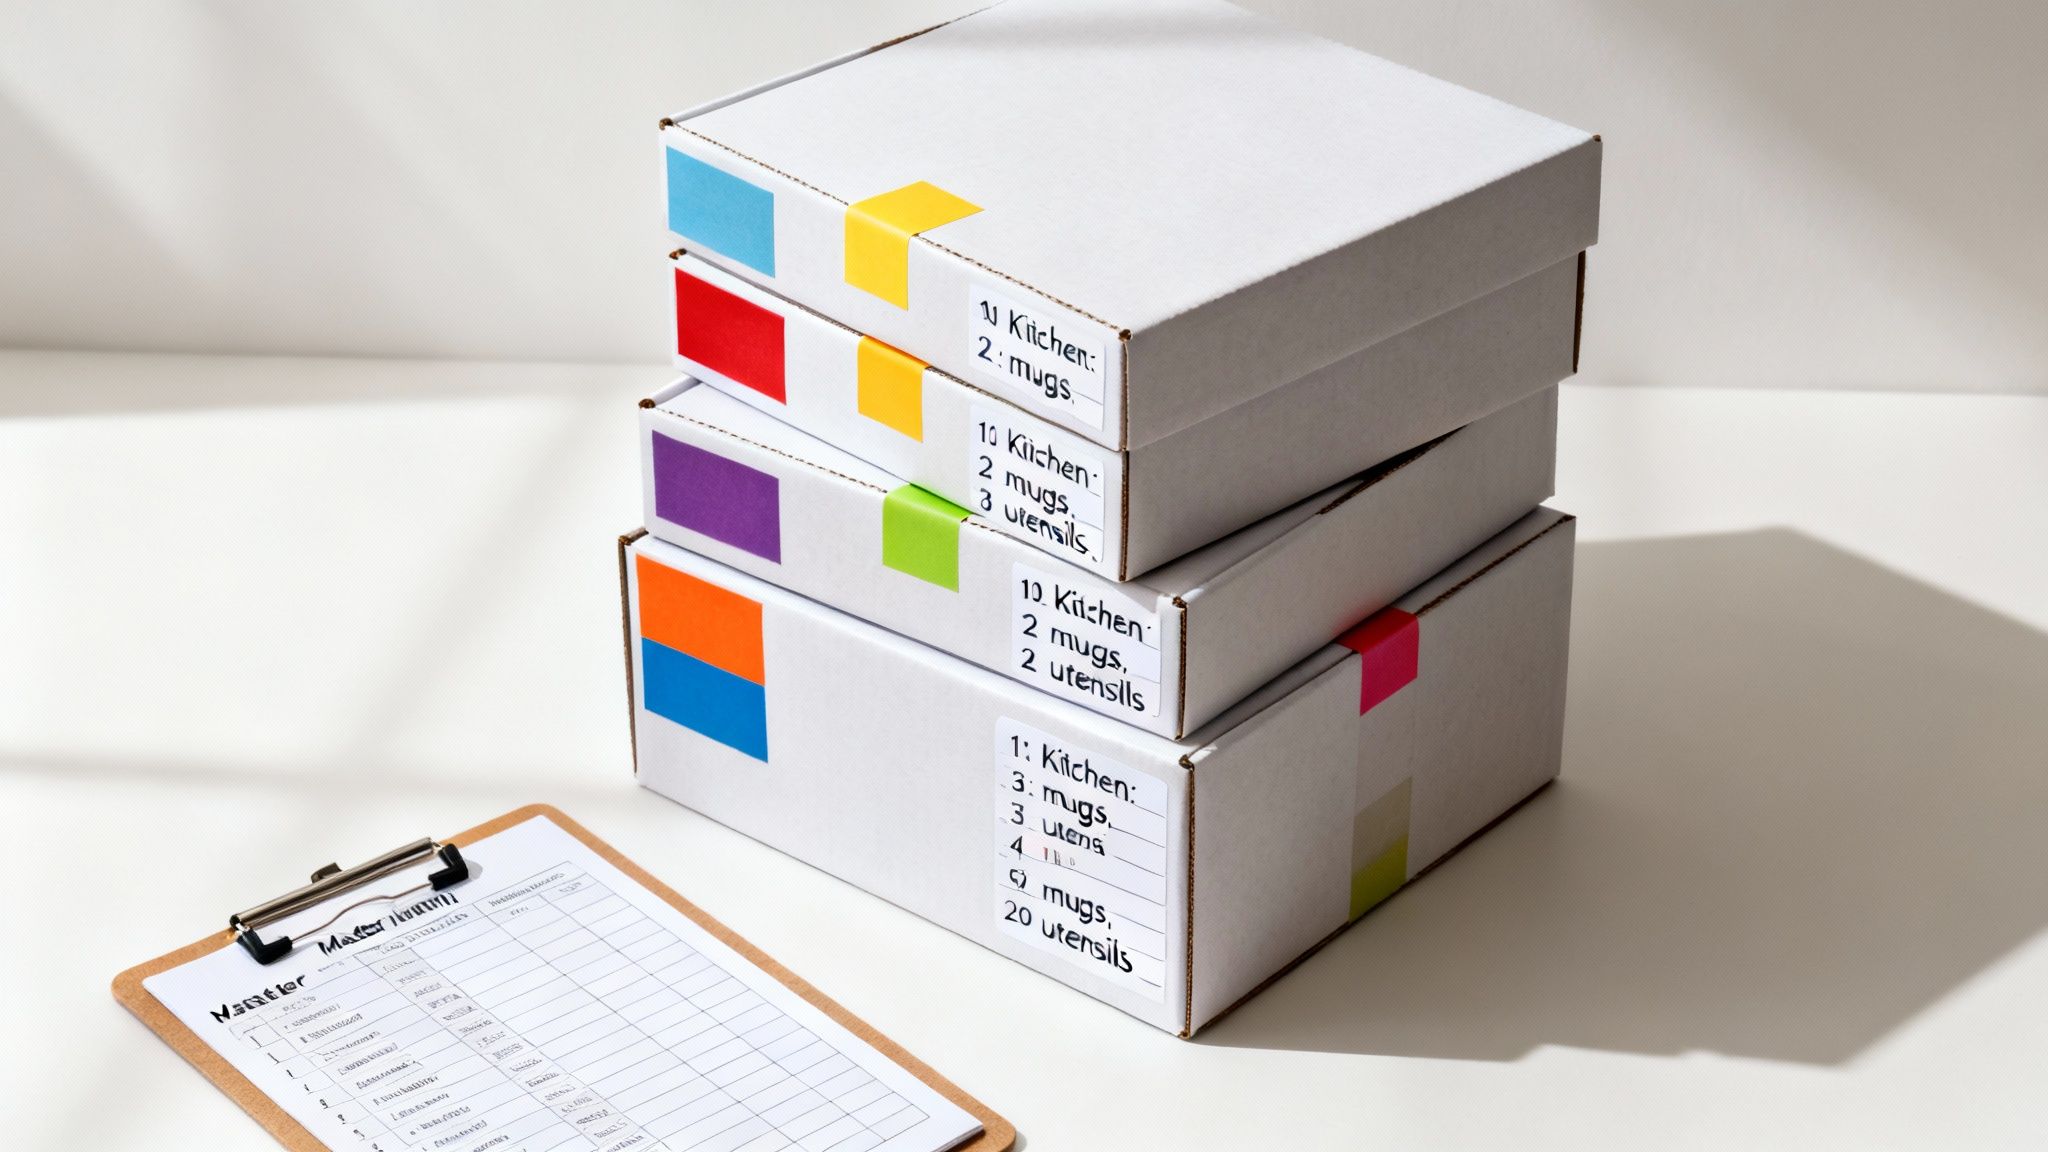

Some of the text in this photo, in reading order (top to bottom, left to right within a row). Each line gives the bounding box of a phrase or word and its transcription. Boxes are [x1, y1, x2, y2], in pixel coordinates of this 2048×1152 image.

[978, 455, 993, 479] 2
[1022, 613, 1038, 638] 2
[1021, 648, 1037, 672] 2
[1042, 743, 1136, 804] Kitchen:
[1011, 802, 1024, 825] 3
[1010, 836, 1023, 860] 4
[1004, 900, 1133, 973] 20 utensils
